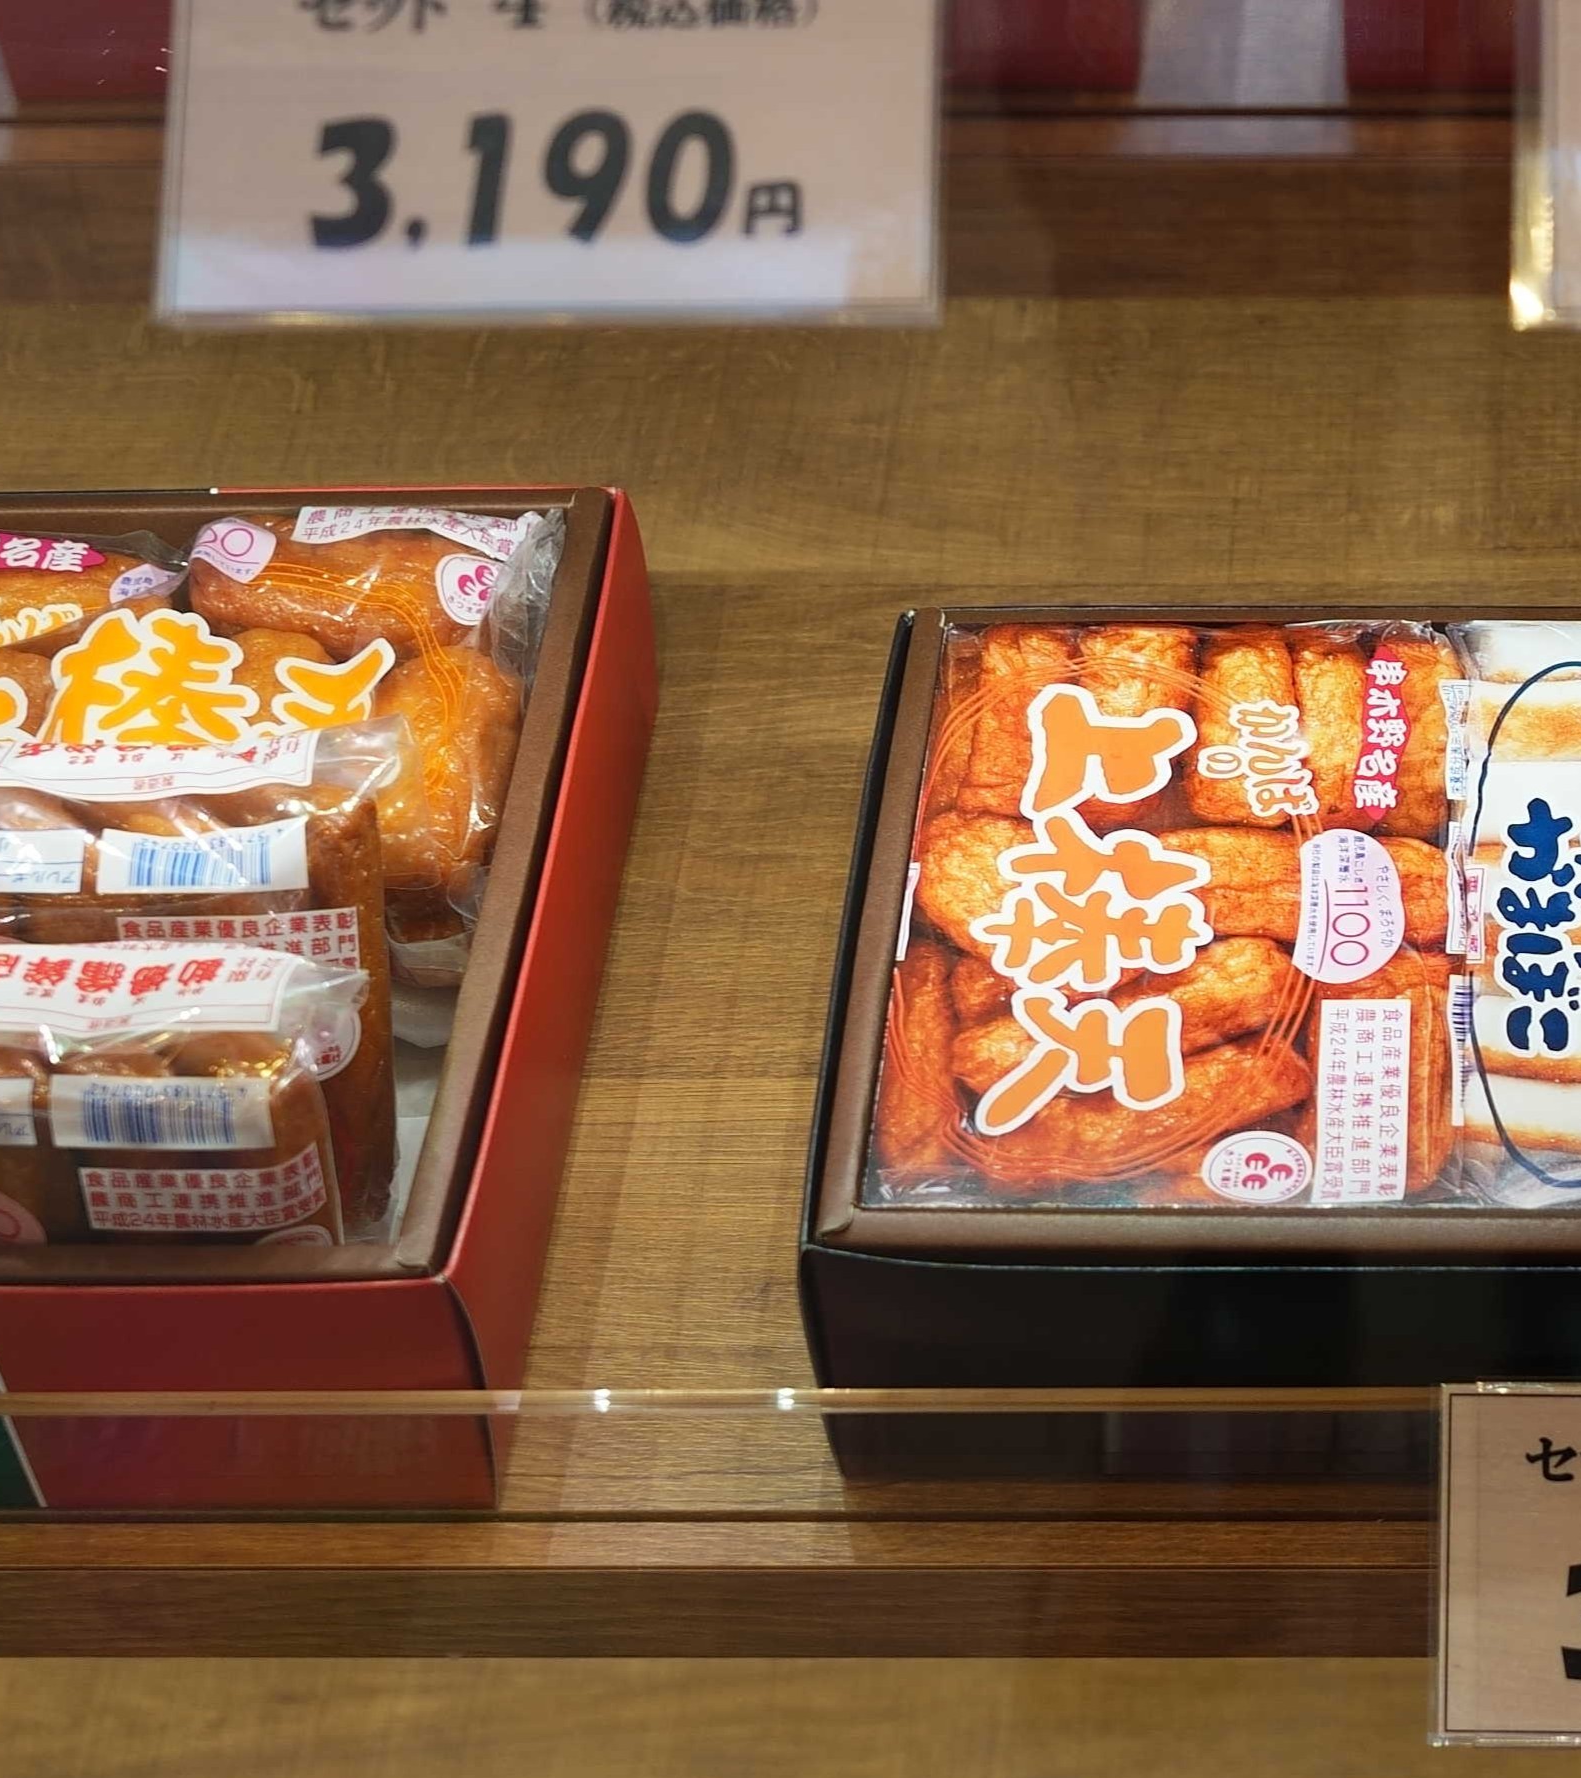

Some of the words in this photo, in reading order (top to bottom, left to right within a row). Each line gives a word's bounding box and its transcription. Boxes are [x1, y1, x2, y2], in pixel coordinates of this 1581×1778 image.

[1199, 701, 1318, 817] かんばの
[1353, 656, 1409, 811] 串木野名産
[977, 686, 1207, 1134] 上棒天
[1329, 885, 1372, 967] 1100
[1497, 796, 1579, 1052] かまぼこ
[1320, 1007, 1349, 1201] 平成24年農林水産大臣賞受賞
[1348, 1007, 1376, 1197] 農商工連携推進部門
[1377, 1007, 1405, 1199] 食品産業優良企業表彰
